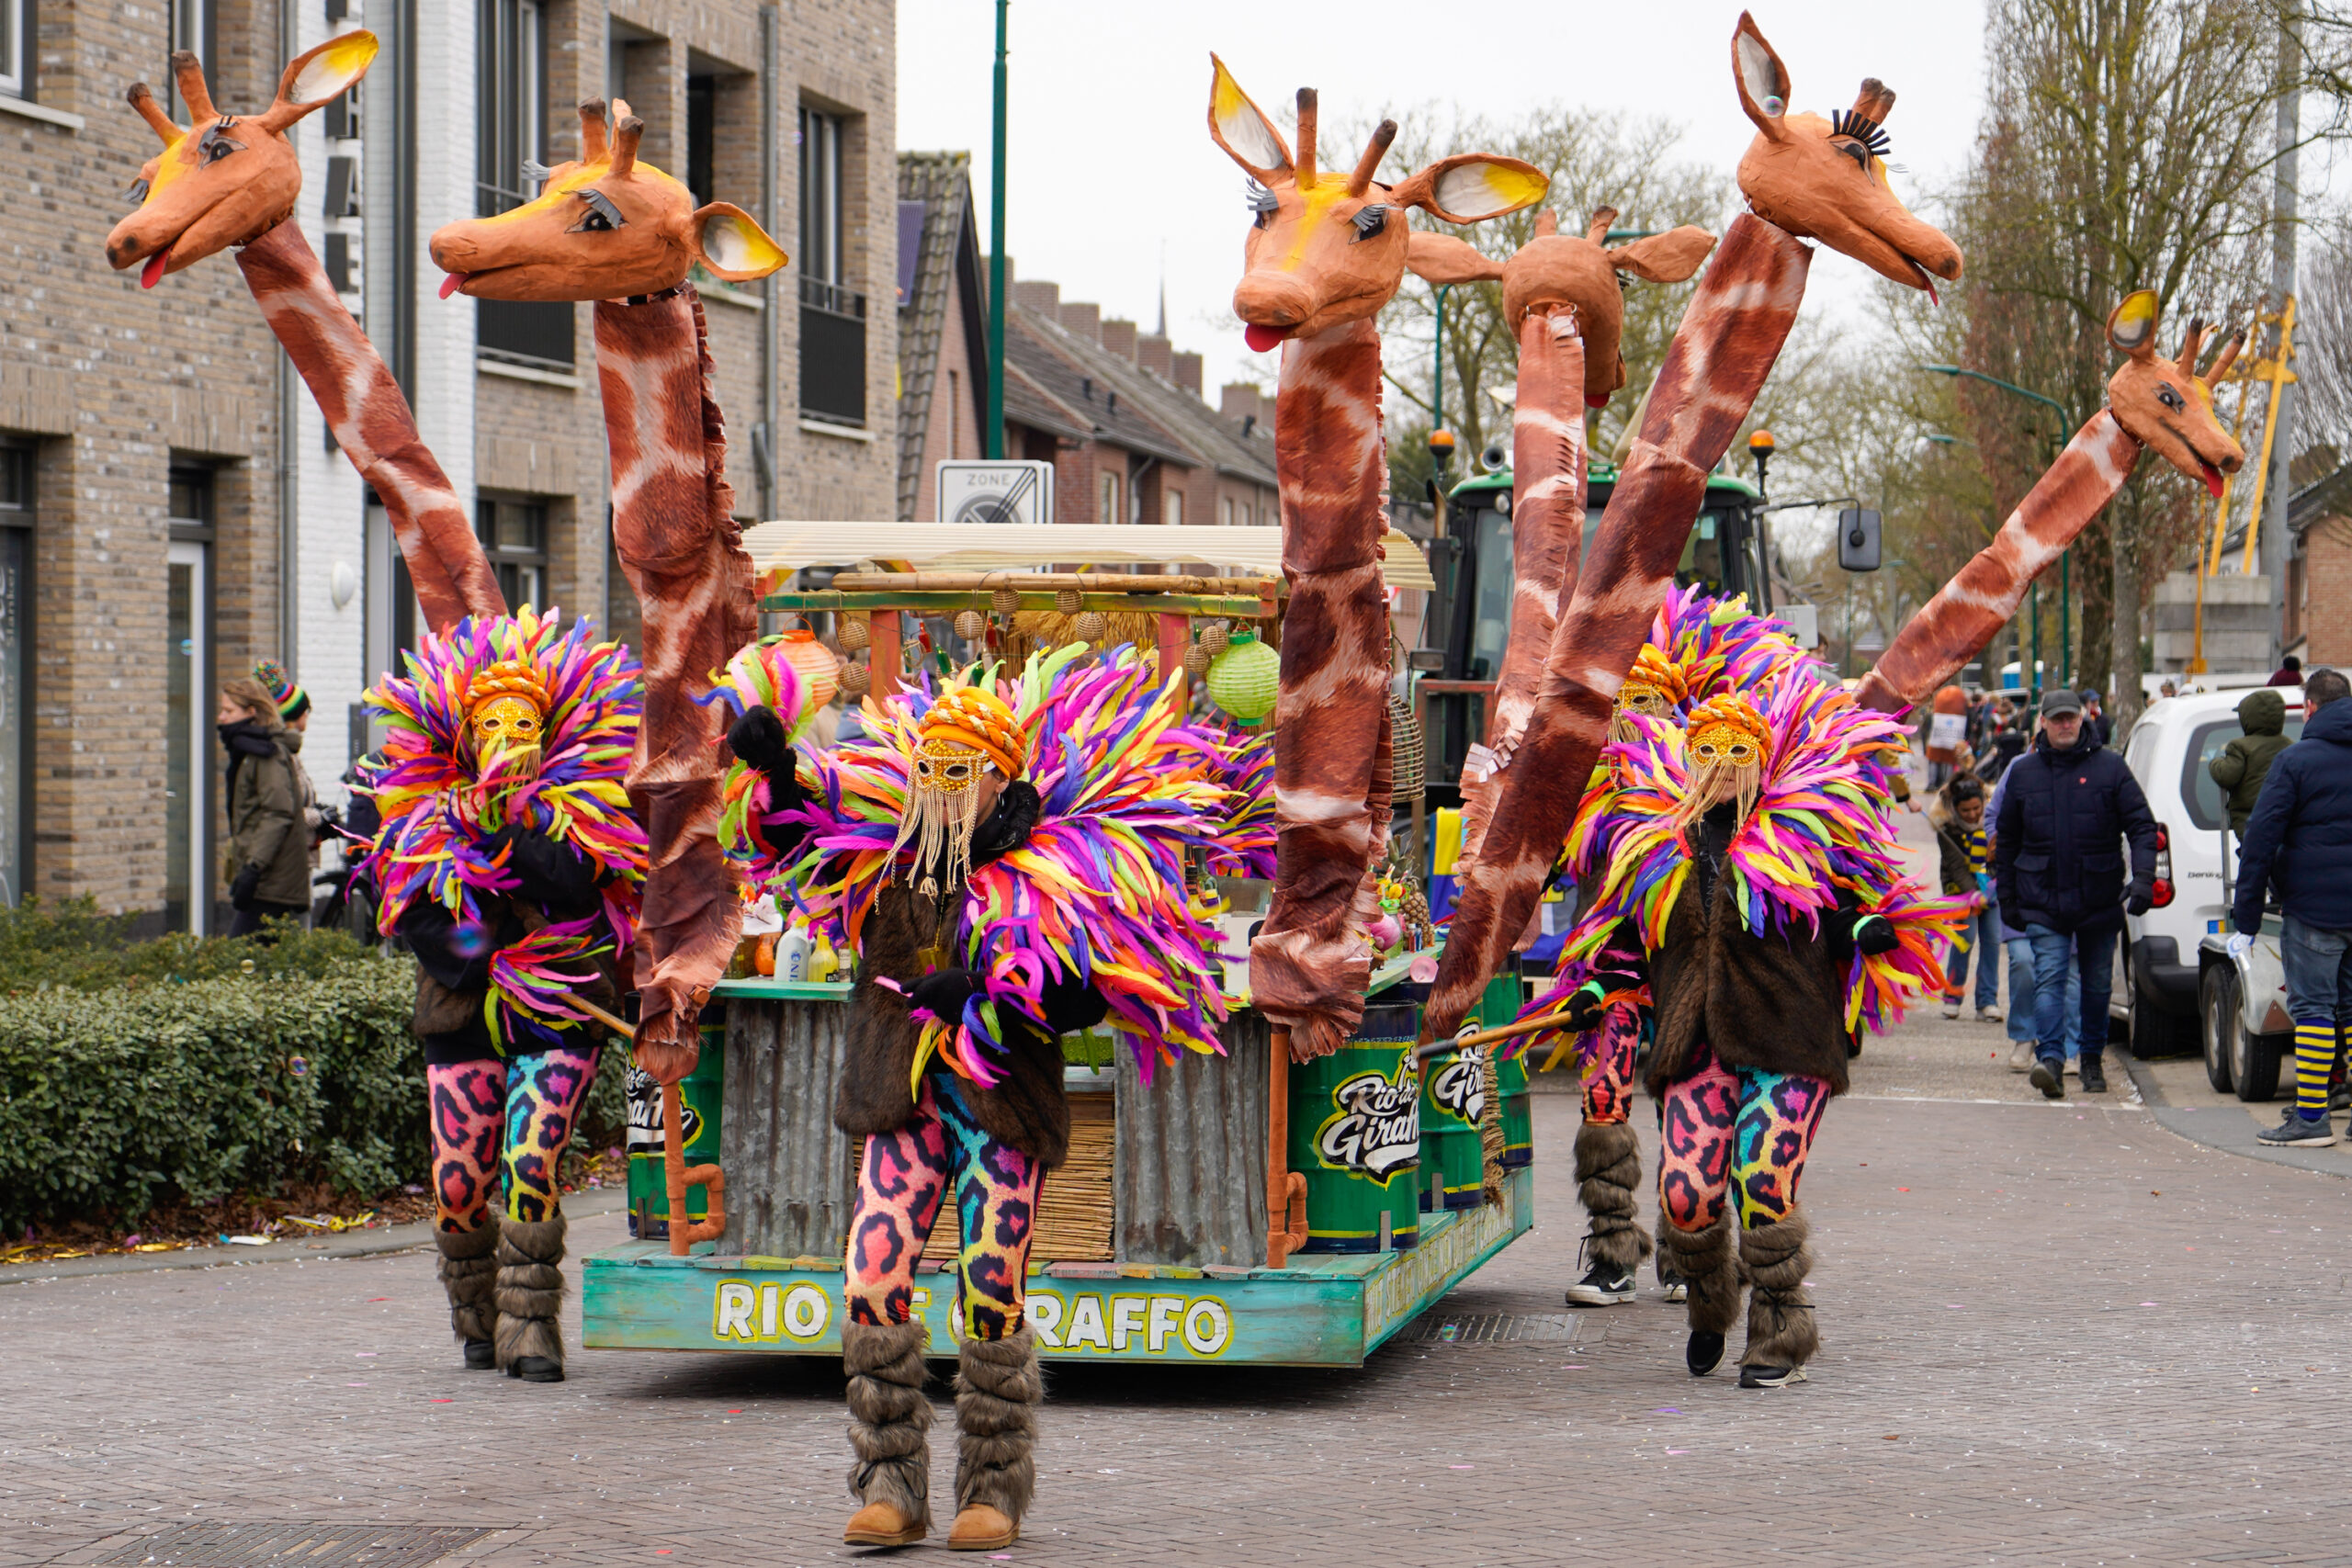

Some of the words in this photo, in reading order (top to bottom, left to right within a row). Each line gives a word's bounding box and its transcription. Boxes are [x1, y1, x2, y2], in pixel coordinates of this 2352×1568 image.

[967, 473, 1011, 486] ZONE
[6, 567, 15, 648] Slanker
[1339, 1076, 1400, 1116] Rio
[715, 1280, 831, 1341] RIO
[949, 1292, 1231, 1357] RAFFO
